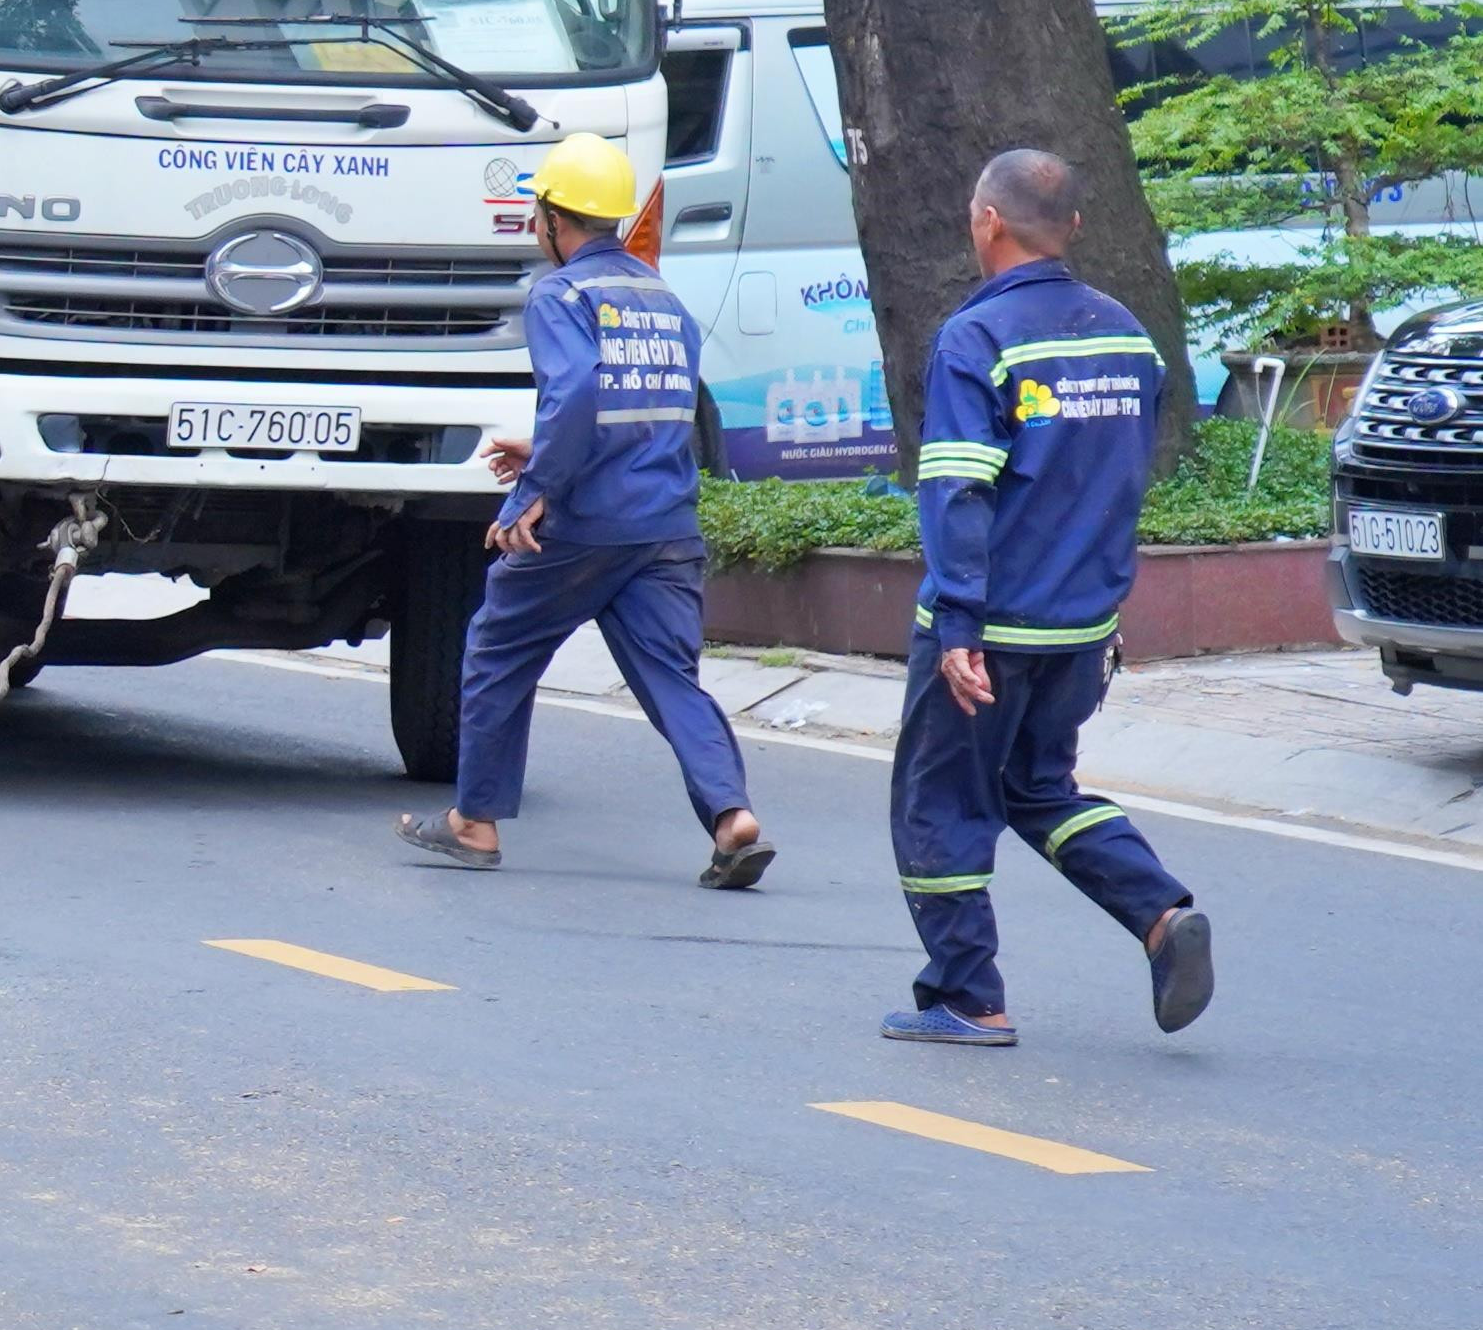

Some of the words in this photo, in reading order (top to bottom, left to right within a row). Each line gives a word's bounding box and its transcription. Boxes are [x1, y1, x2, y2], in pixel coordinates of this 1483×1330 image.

[158, 144, 217, 171] CÔNG
[225, 146, 276, 173] VIÊN
[283, 150, 325, 175] CÂY
[333, 155, 390, 178] XANH
[801, 272, 871, 307] KHÔN
[599, 331, 625, 365] ÔNG
[177, 407, 353, 445] 51C-760.05
[835, 443, 888, 458] HYDROGEN
[1351, 513, 1440, 554] 51G-510.23
